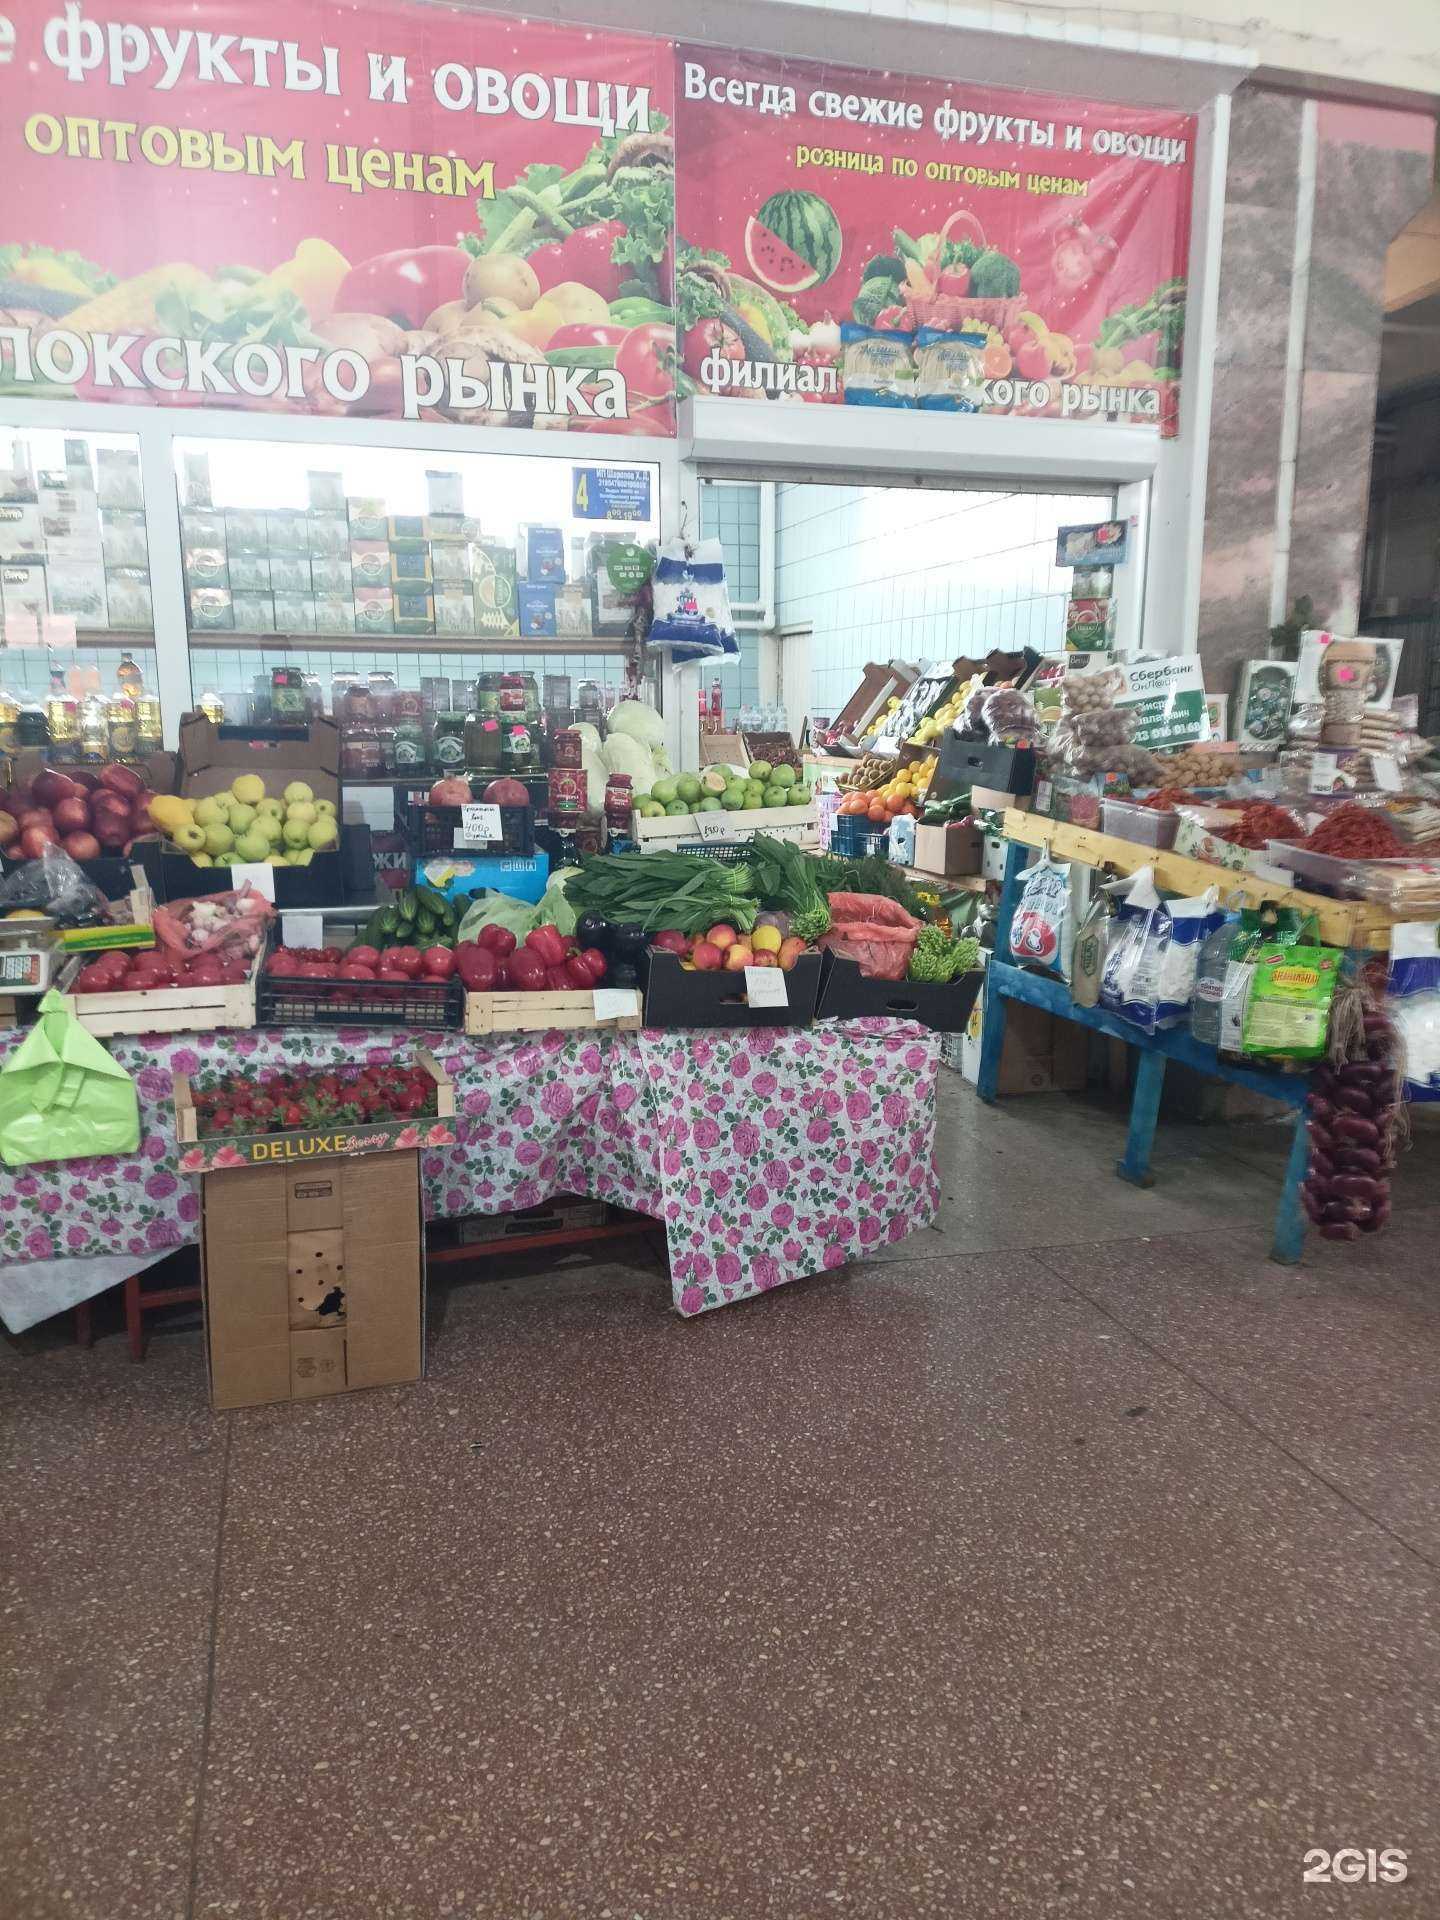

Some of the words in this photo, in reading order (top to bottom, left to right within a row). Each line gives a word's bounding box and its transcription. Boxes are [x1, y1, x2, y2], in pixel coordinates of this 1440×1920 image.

[43, 0, 342, 95] фрукты
[366, 52, 410, 105] и
[433, 62, 653, 138] овощи
[684, 61, 798, 117] Всегда
[808, 90, 924, 130] свежие
[934, 99, 1056, 149] фрукты
[1064, 127, 1083, 152] и
[1093, 129, 1187, 165] овощи
[24, 112, 306, 180] оптовым
[326, 143, 498, 200] ценам
[796, 144, 885, 176] розница
[891, 158, 918, 178] по
[925, 163, 1021, 191] оптовым
[1027, 174, 1090, 198] ценам
[399, 353, 630, 420] рынка
[700, 348, 840, 395] филиал
[1061, 384, 1162, 415] рынка
[576, 473, 589, 513] 4
[1129, 664, 1194, 683] Сбербанк
[253, 1134, 347, 1161] DELUXE
